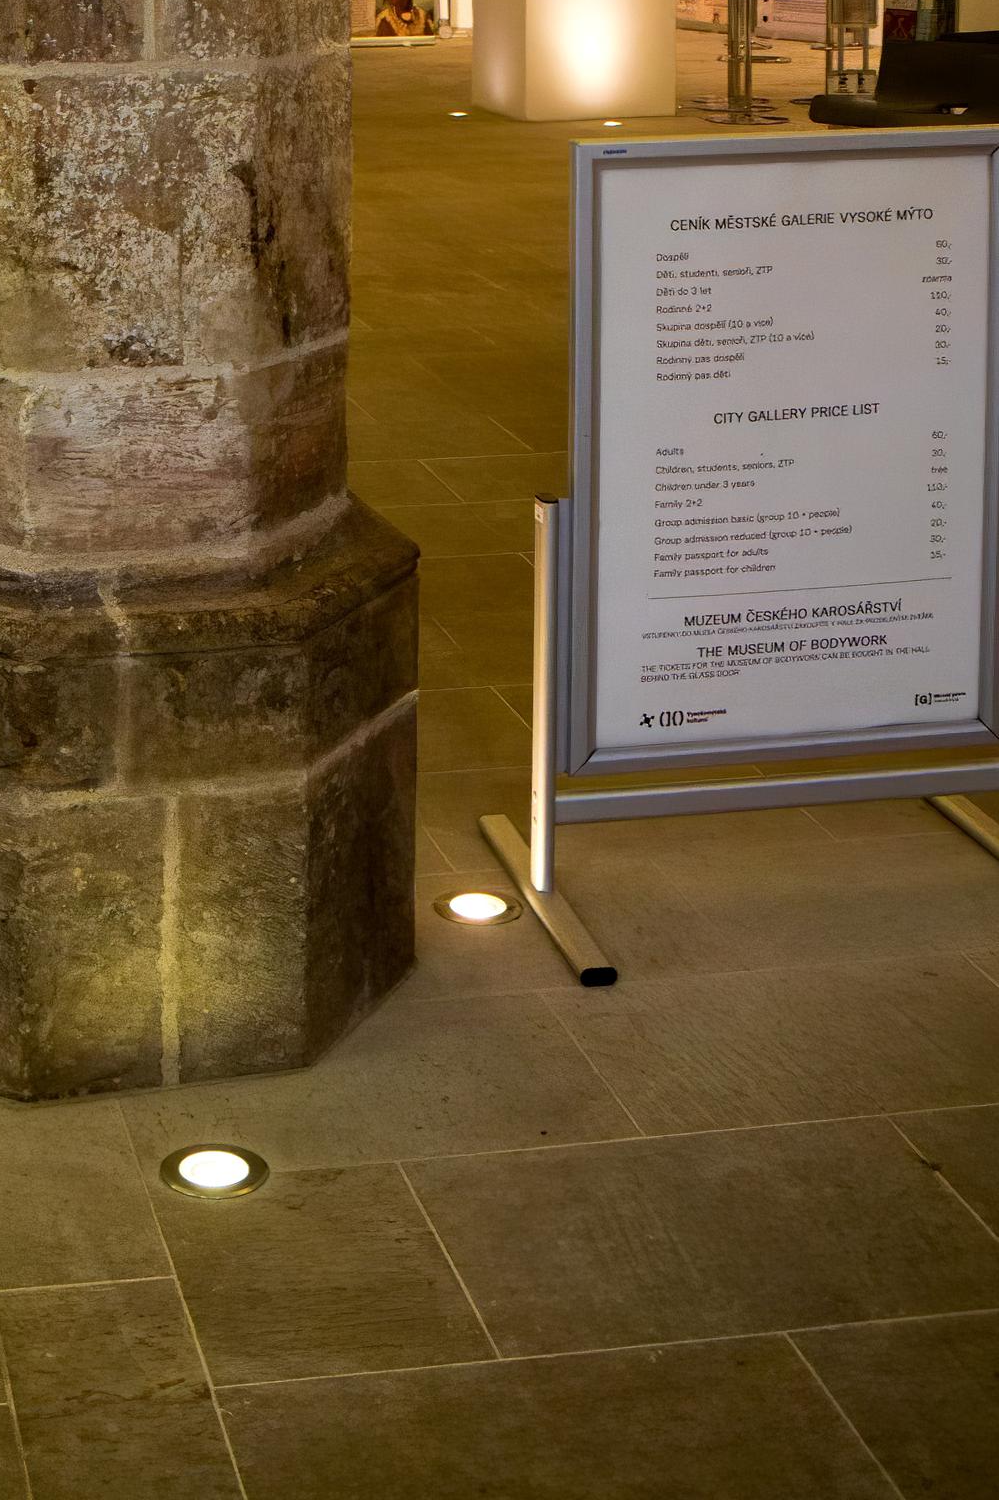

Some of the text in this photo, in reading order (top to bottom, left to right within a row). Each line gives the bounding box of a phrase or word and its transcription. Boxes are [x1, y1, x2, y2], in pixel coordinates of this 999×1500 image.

[670, 207, 933, 231] CENÍK MĚSTSKÉ GALERIE VYSOKÉ MÝTO
[756, 265, 773, 275] ZTP
[678, 287, 688, 296] do
[691, 286, 697, 296] 3
[699, 285, 712, 296] let
[695, 304, 712, 313] 2+2
[750, 334, 767, 344] ZTP
[695, 355, 711, 365] pas
[695, 371, 711, 381] pas
[713, 402, 880, 424] CITY GALLERY PRICE LIST
[656, 448, 684, 456] Adults
[777, 459, 794, 468] ZTP
[655, 482, 691, 492] Children
[695, 481, 719, 490] under
[731, 480, 755, 489] years
[654, 500, 683, 509] Family
[654, 518, 683, 528] Group
[685, 517, 728, 527] admission
[731, 515, 754, 524] basic
[757, 512, 784, 523] (group
[654, 536, 682, 546] Group
[684, 534, 728, 545] admission
[730, 532, 766, 542] reduced
[654, 553, 682, 562] Family
[685, 550, 724, 561] passport
[727, 549, 739, 558] for
[742, 548, 769, 557] adults
[653, 569, 682, 578] Family
[684, 567, 724, 577] passport
[726, 565, 739, 574] for
[740, 563, 776, 573] children
[684, 613, 742, 627] MUZEUM
[746, 607, 808, 622] ČESKÉHO
[812, 598, 902, 618] KAROSÁŘSTVÍ
[697, 634, 888, 657] THE MUSEUM OF BODYWORK
[642, 665, 656, 673] THE
[660, 663, 690, 671] TICKETS
[692, 662, 708, 670] FOR
[727, 658, 760, 667] MUSEUM
[852, 649, 883, 658] BOUGHT
[911, 646, 930, 654] HALL
[641, 674, 669, 683] BEHIND
[671, 673, 687, 681] THE
[689, 671, 715, 679] GLASS
